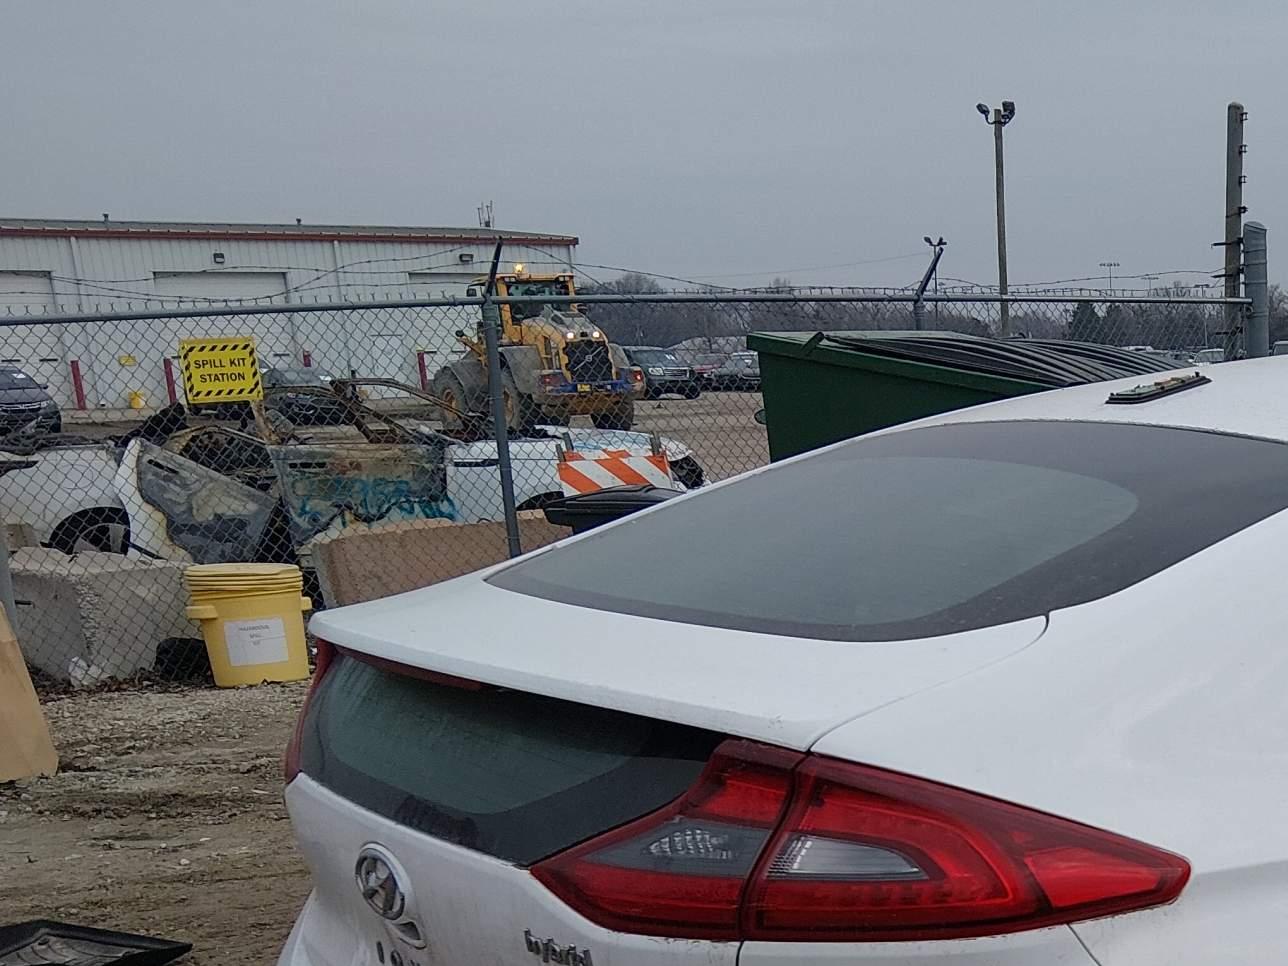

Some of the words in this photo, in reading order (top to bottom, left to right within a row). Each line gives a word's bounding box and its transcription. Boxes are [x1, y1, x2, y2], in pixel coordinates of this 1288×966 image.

[193, 358, 226, 369] SPILL
[229, 357, 247, 367] KIT
[200, 371, 246, 383] STATION
